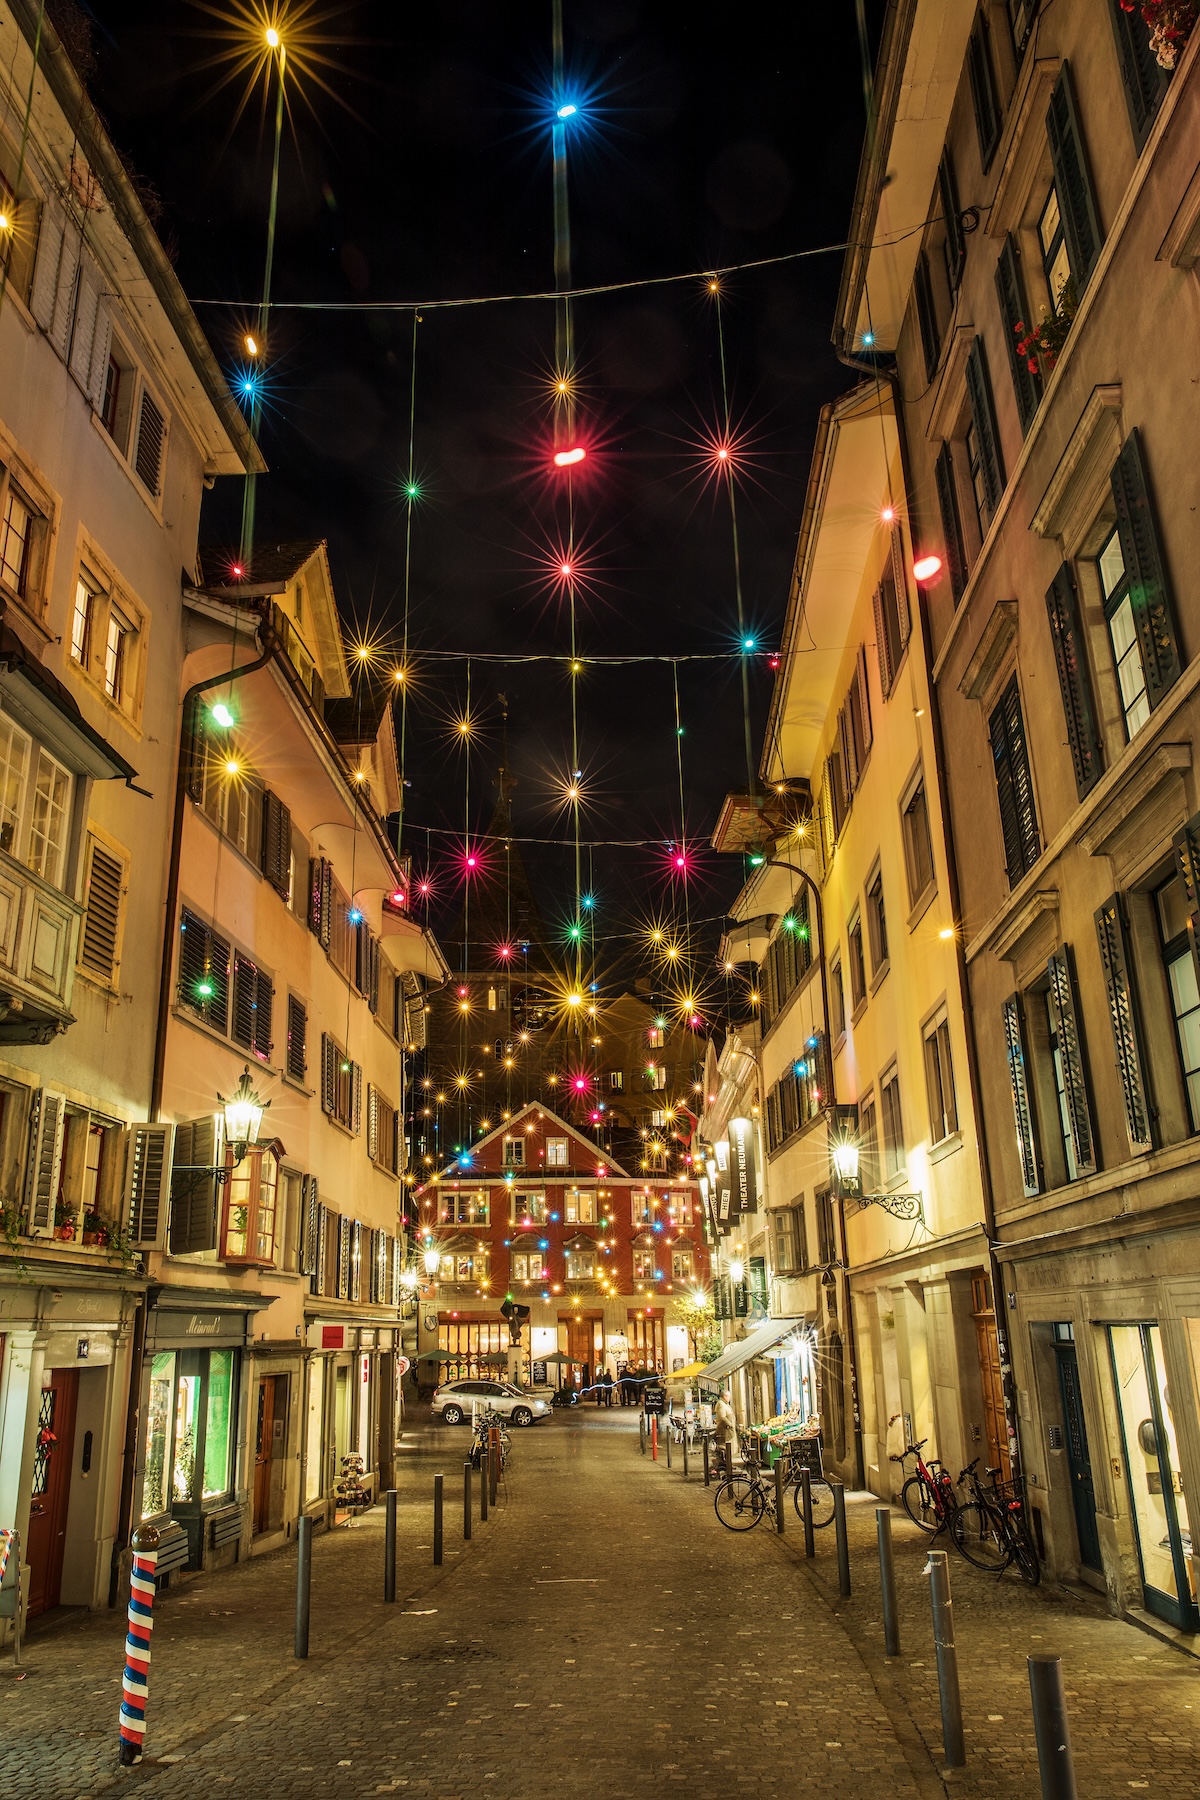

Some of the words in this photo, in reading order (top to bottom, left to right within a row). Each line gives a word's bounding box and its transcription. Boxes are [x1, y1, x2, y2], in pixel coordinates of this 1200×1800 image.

[737, 1128, 747, 1170] NEUMARK
[739, 1171, 748, 1209] THEATER
[185, 1315, 221, 1334] Meinrad's
